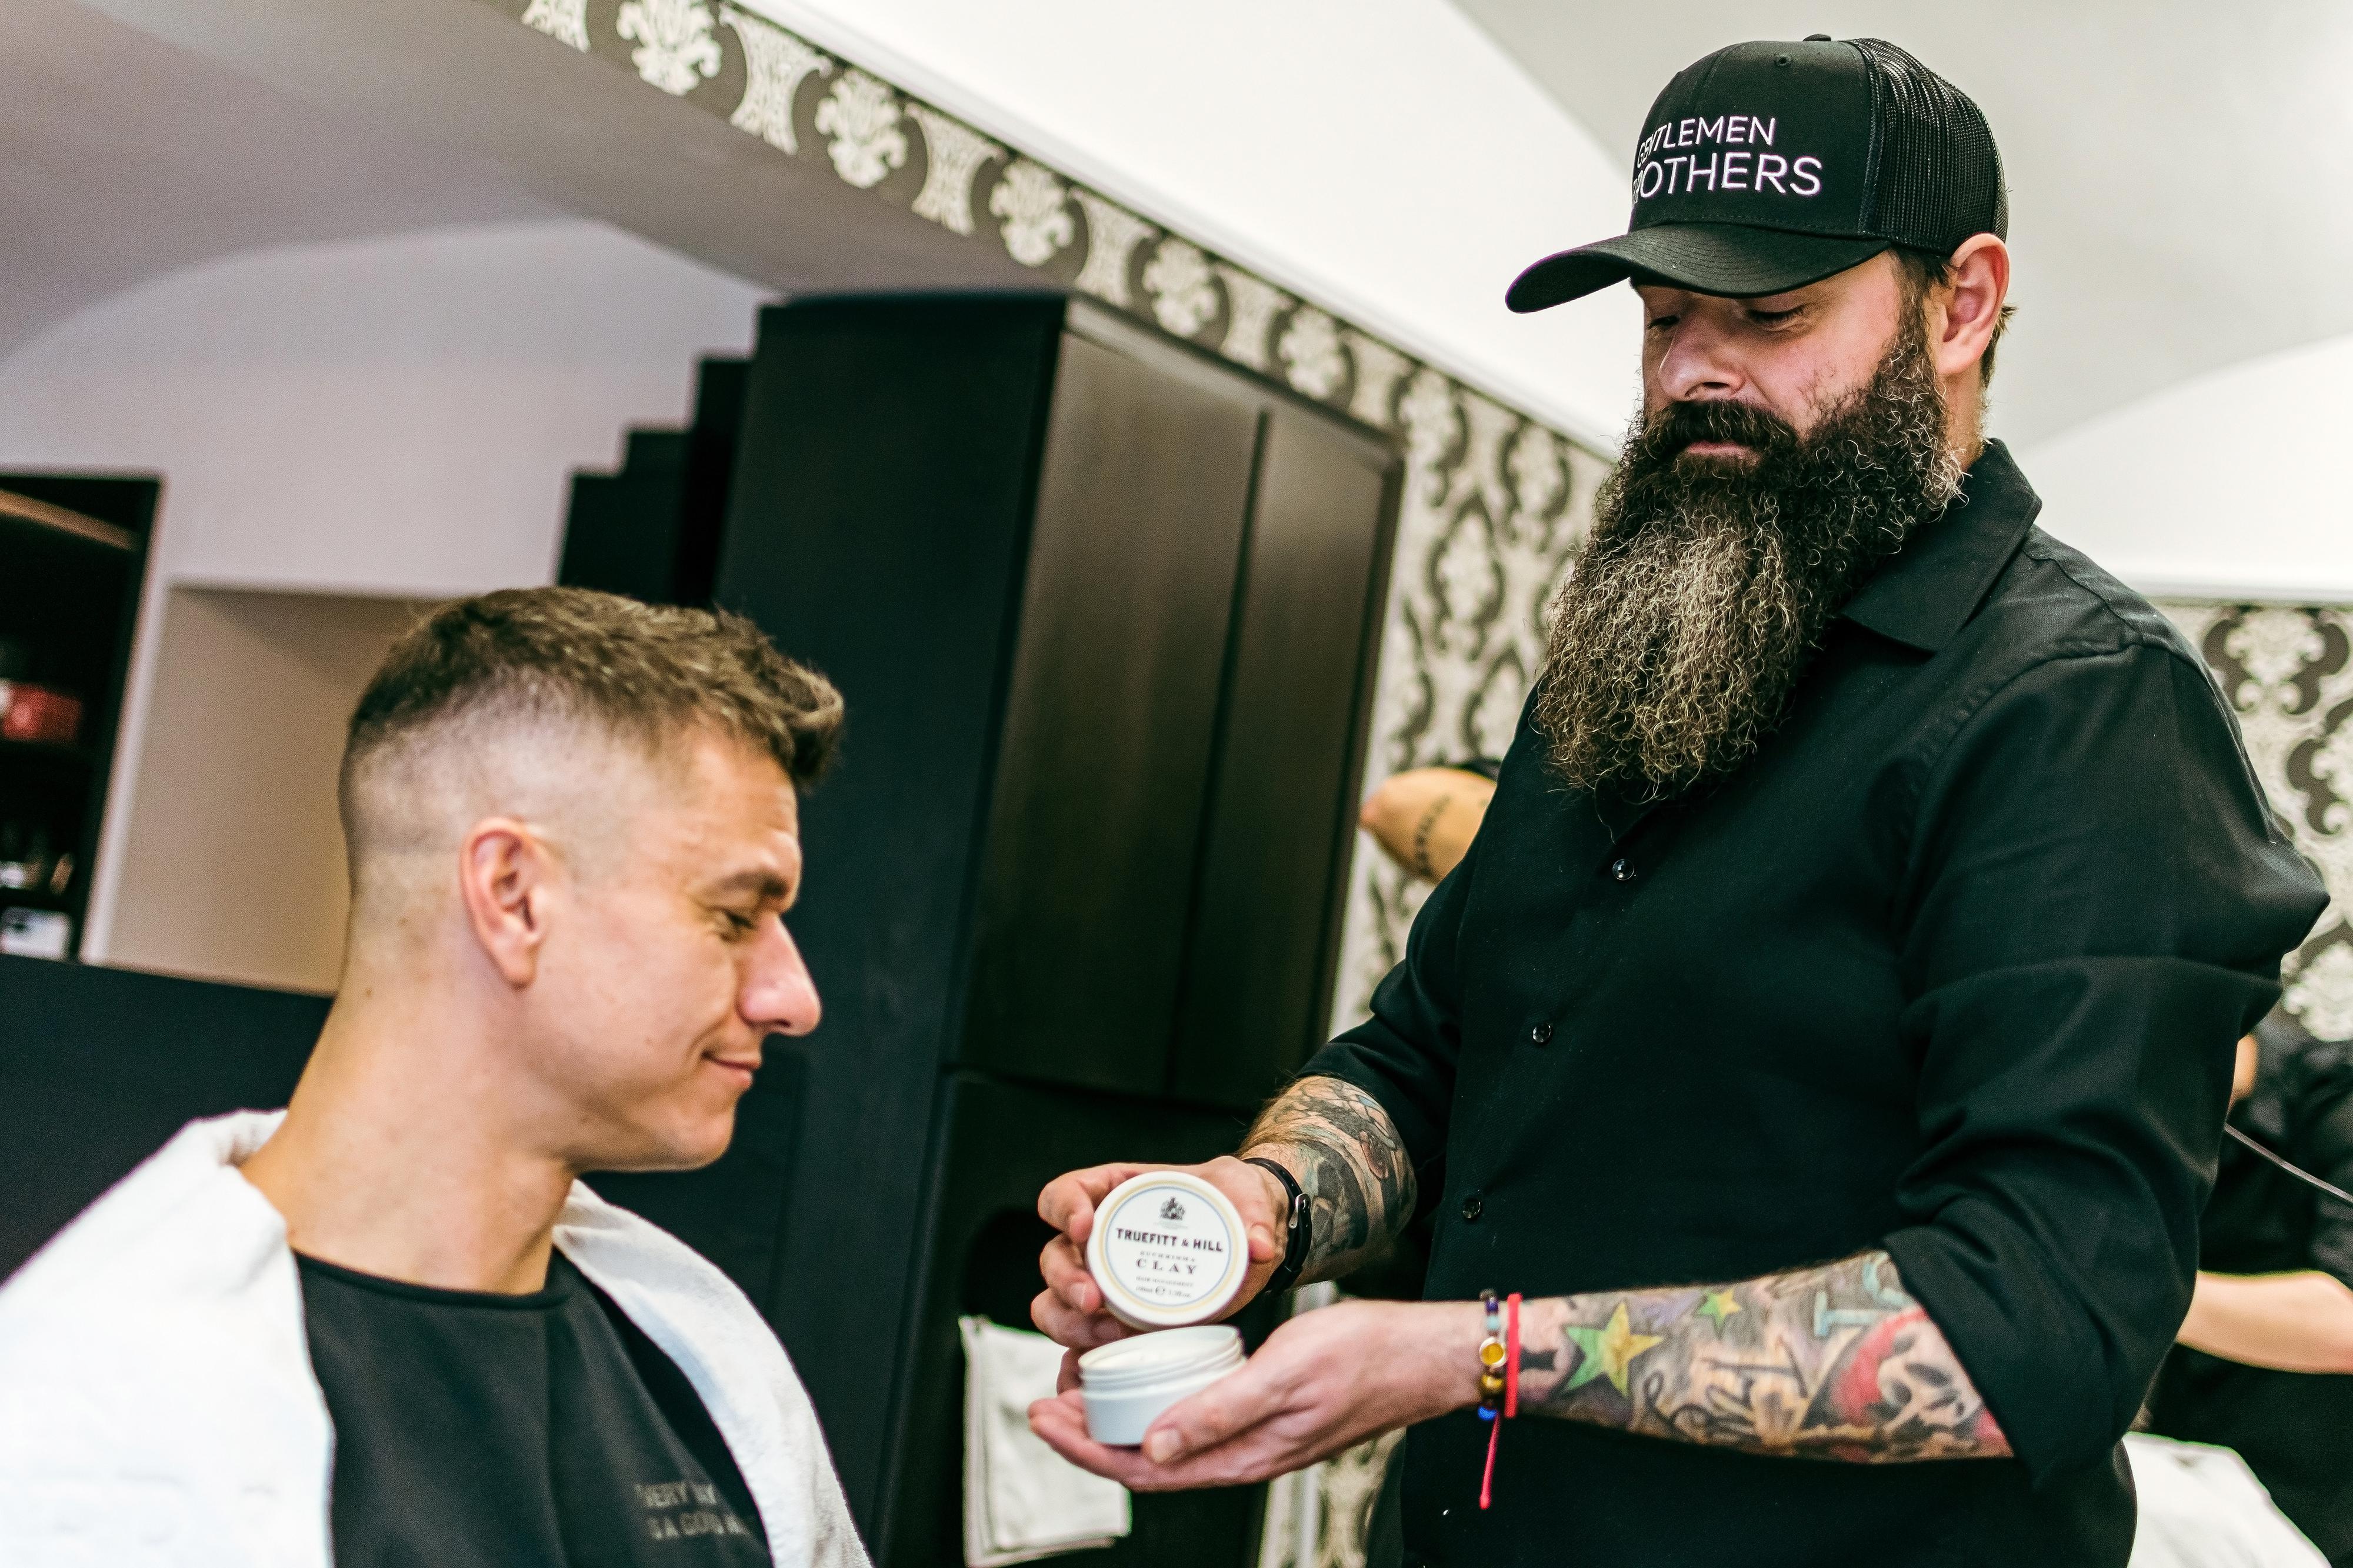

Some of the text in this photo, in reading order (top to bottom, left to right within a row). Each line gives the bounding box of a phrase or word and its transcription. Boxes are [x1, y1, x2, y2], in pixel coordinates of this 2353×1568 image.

[1637, 116, 1776, 168] GENTLEMEN
[1116, 1227, 1223, 1253] TRUEFITT & HILL
[1135, 1257, 1197, 1275] CLAY
